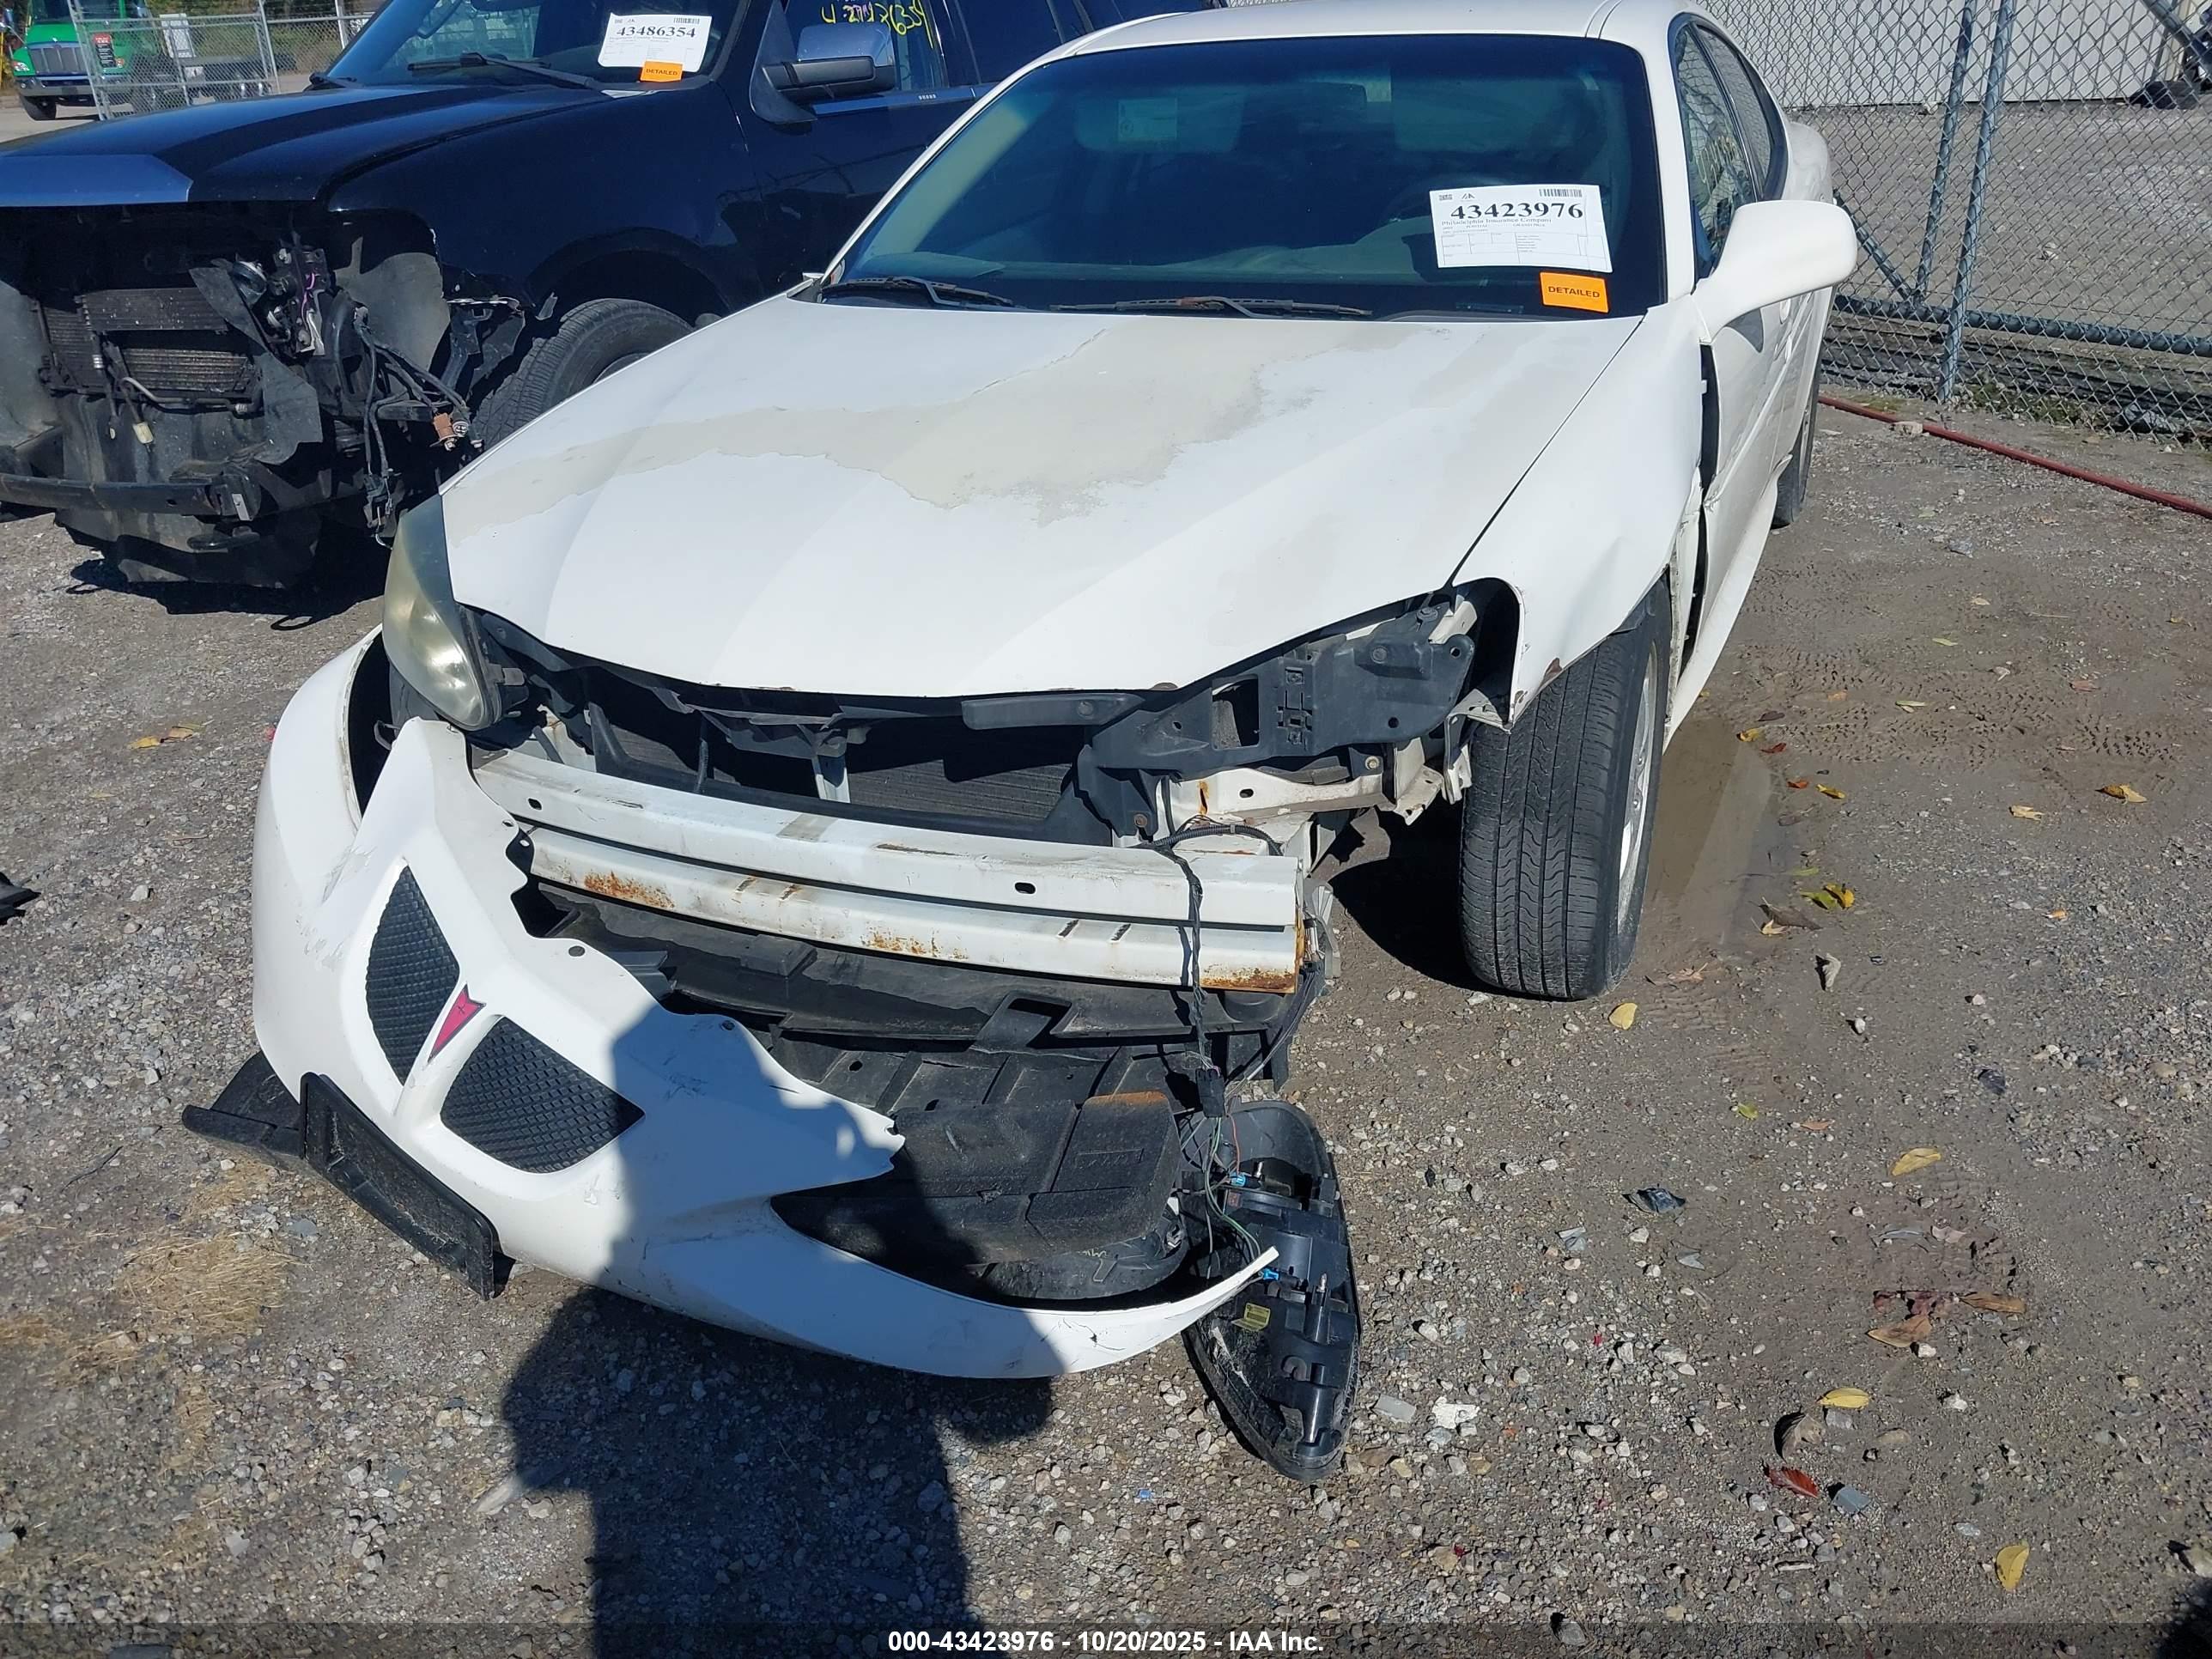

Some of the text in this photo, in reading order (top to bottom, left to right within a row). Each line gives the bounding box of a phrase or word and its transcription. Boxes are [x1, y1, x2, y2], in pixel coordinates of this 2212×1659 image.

[617, 26, 696, 38] 43486354
[646, 68, 678, 76] DETAILED
[1450, 202, 1584, 219] 43423976
[1547, 285, 1601, 299] DETAILED
